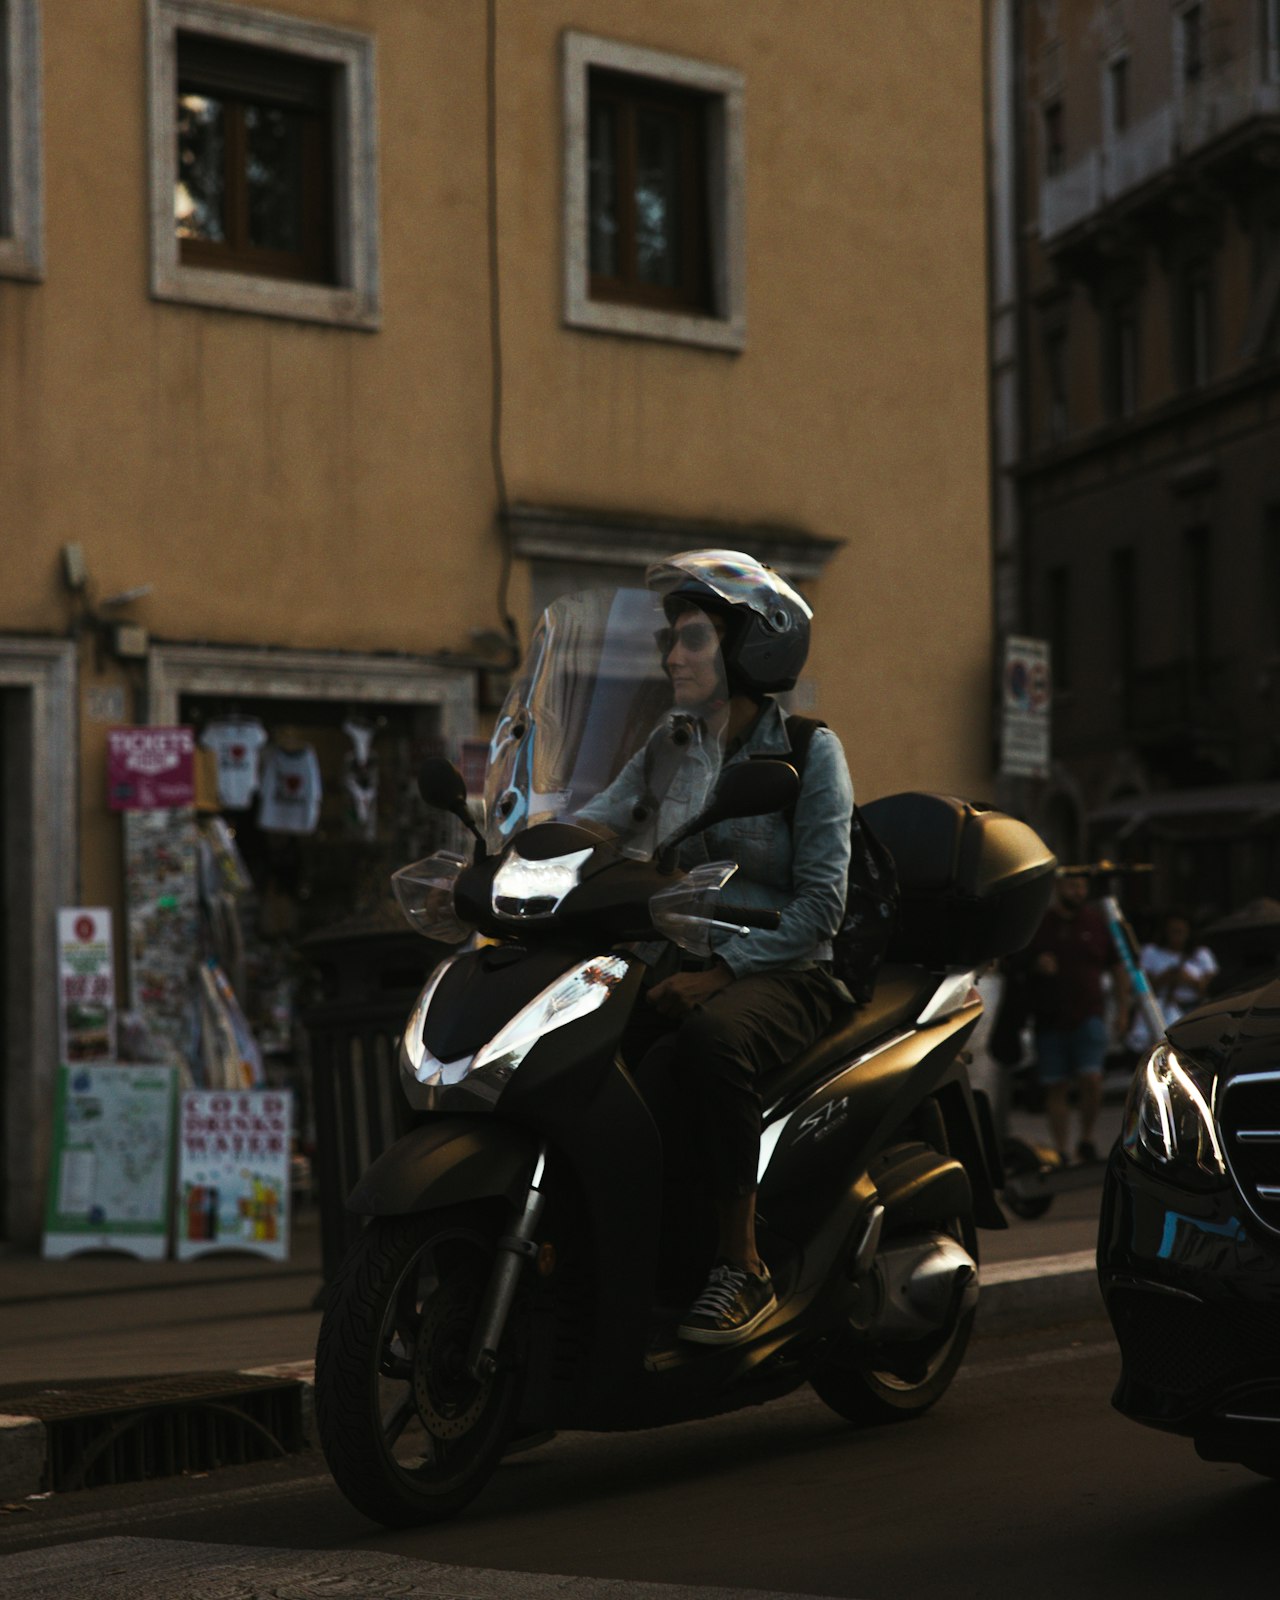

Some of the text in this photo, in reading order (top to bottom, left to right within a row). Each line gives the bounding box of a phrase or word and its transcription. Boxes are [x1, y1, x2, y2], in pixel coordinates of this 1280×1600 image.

[109, 732, 194, 754] TICKETS
[186, 1097, 284, 1113] COLD
[186, 1117, 284, 1132] DRINKS
[186, 1136, 283, 1151] WATER
